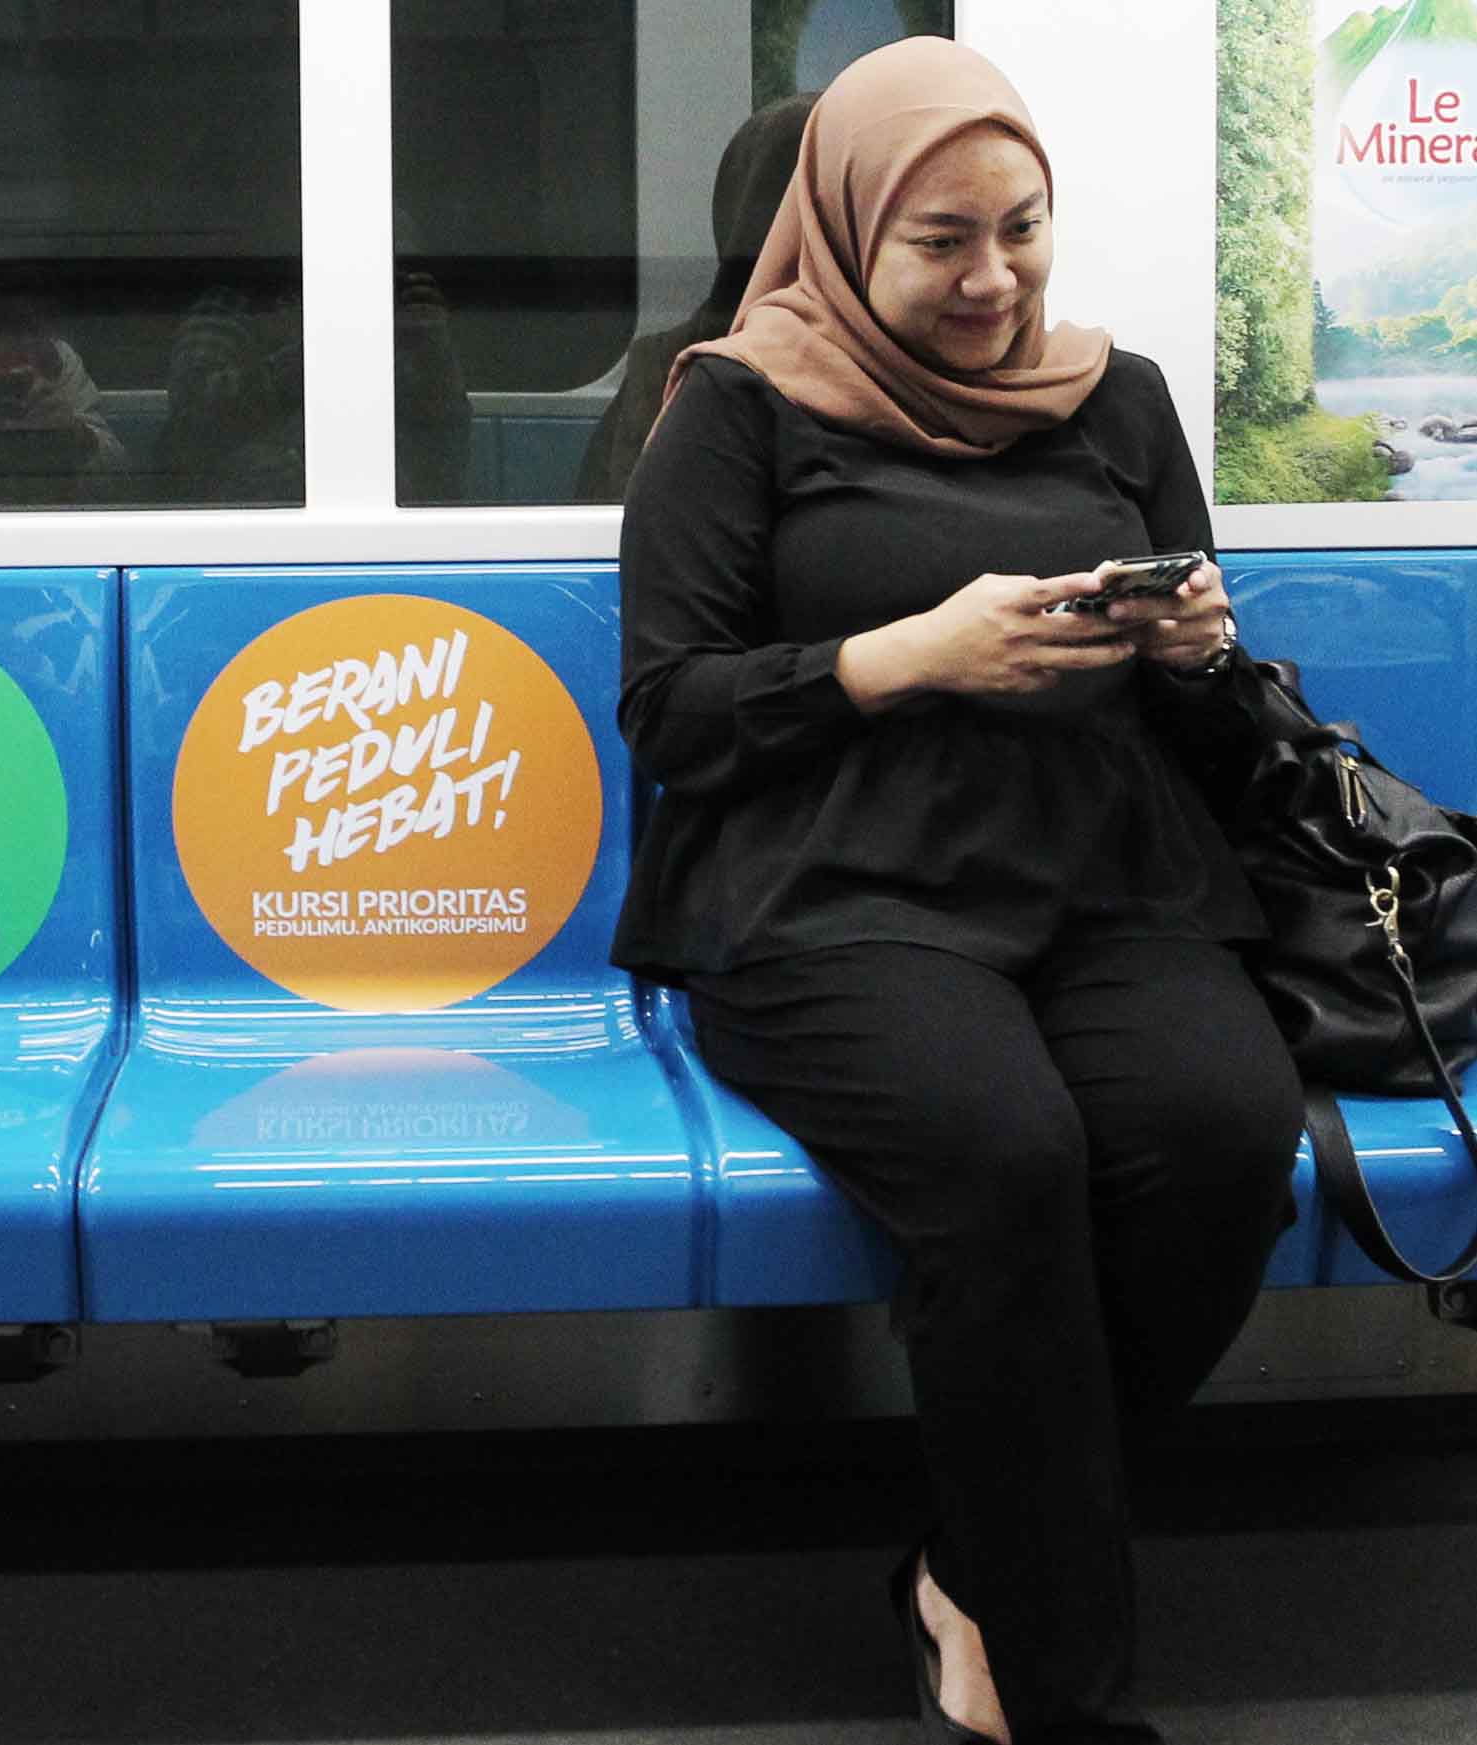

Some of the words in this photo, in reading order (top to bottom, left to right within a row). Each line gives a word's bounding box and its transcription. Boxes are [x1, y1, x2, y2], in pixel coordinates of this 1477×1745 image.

[1409, 78, 1460, 123] Le
[1336, 122, 1477, 164] Miner
[238, 629, 468, 752] BERANI
[267, 700, 492, 816] PEDULI
[284, 749, 520, 873] HEBAT!
[252, 891, 349, 918] KURSI
[358, 888, 527, 916] PRIORITAS
[363, 918, 526, 936] ANTIKORUPSIMU
